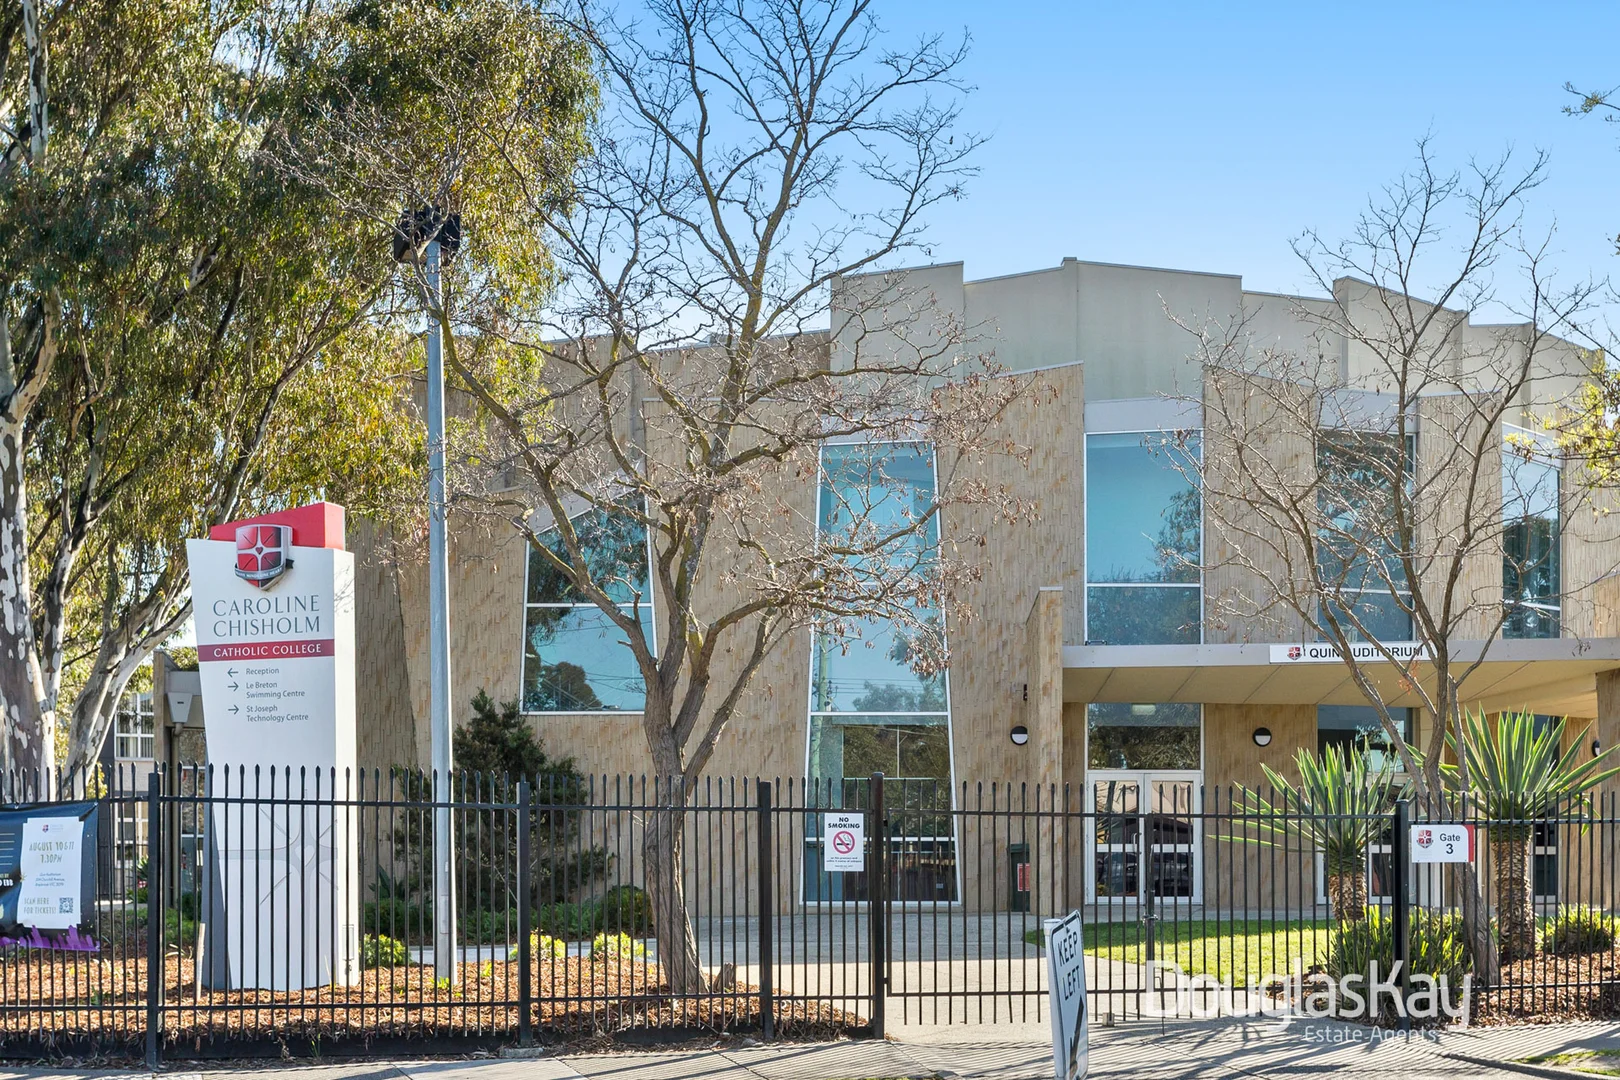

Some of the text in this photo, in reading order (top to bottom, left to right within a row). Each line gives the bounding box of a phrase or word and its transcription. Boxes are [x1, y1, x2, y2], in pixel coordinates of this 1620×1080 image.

[213, 594, 320, 617] CAROLINE
[213, 616, 320, 638] CHISHOLM
[214, 643, 322, 658] CATHOLIC COLLEGE
[1345, 646, 1423, 658] UDITRIUM
[246, 666, 280, 677] Reception
[246, 690, 305, 699] Swimming Centre
[254, 704, 278, 714] Joseph
[246, 714, 285, 723] Technology
[1440, 833, 1461, 842] Gate
[29, 842, 52, 851] AUGUST
[1446, 844, 1454, 854] 3
[1058, 932, 1078, 965] KEEP
[1062, 965, 1081, 1001] LEFT
